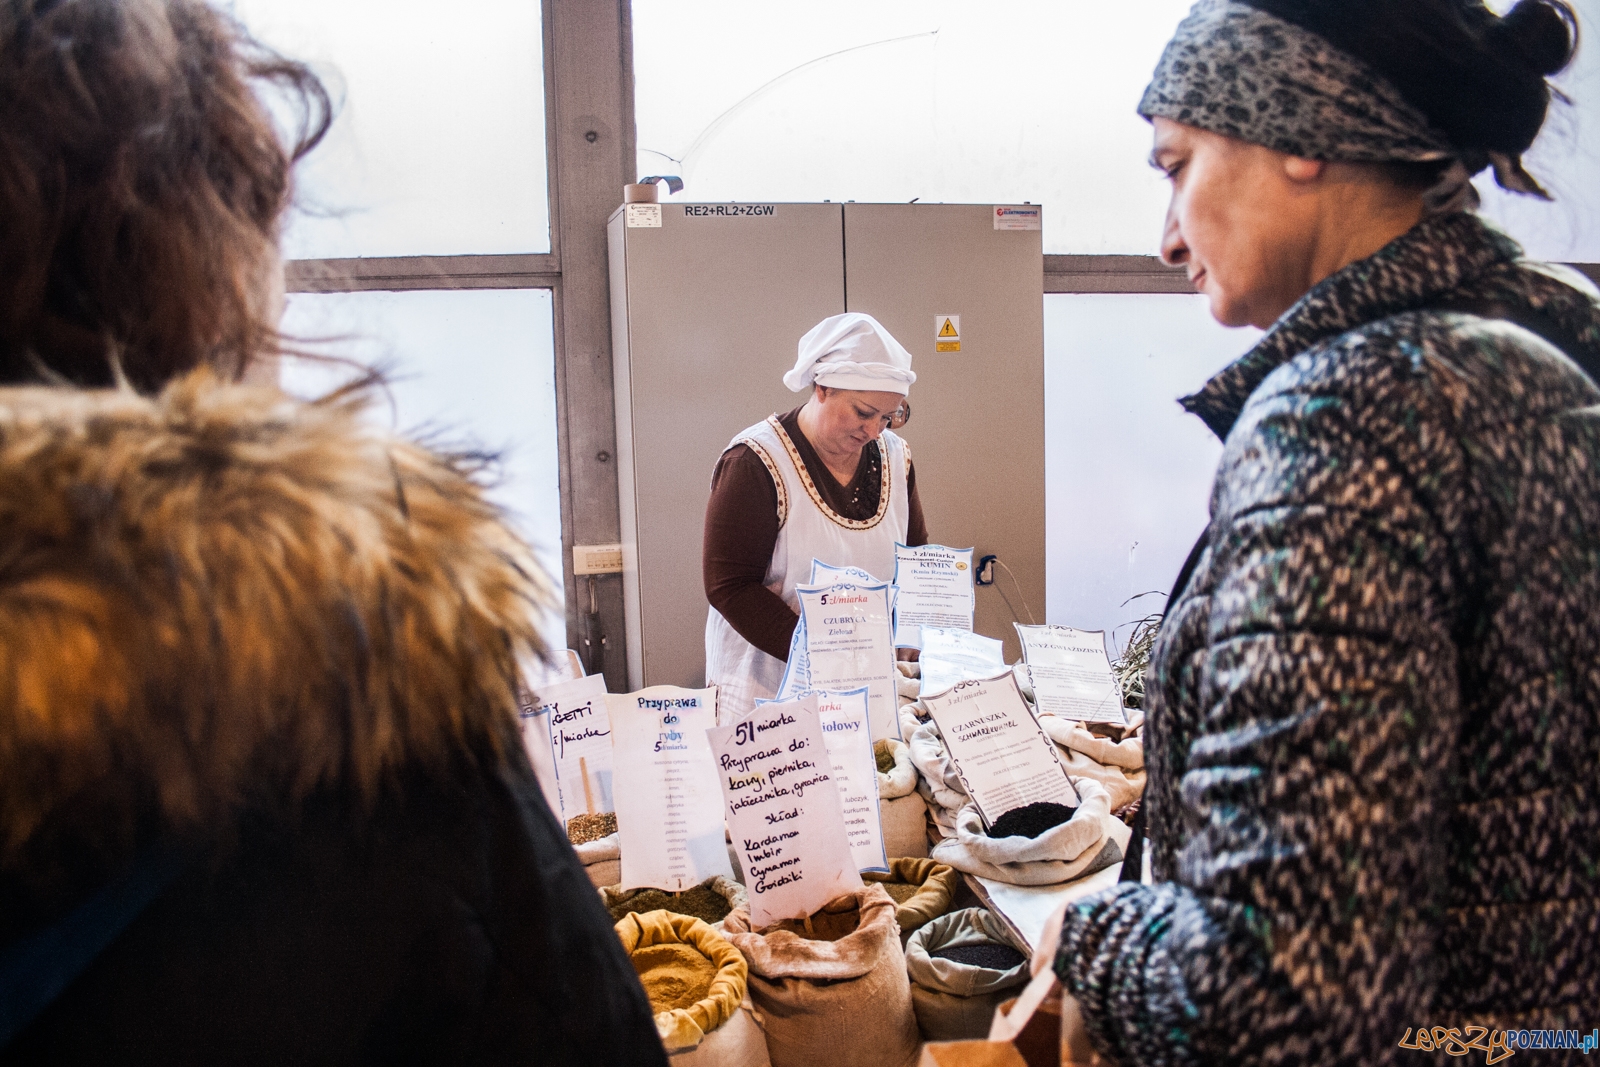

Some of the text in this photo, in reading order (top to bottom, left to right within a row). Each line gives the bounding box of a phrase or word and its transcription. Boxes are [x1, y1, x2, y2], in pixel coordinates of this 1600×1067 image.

[685, 205, 775, 216] RE2+RL2+ZGW
[820, 593, 829, 606] 5
[823, 616, 867, 625] CZUBRYCA
[828, 628, 853, 636] Zielona
[637, 697, 698, 711] Przyprawa
[552, 701, 592, 726] GETTI
[663, 712, 678, 724] do
[757, 713, 797, 733] miarka
[822, 720, 861, 733] iołowy
[951, 711, 1007, 733] CZARNUSZKA
[659, 729, 685, 744] ryby
[653, 741, 663, 752] 5
[720, 737, 810, 773] Przyprawa do:
[729, 759, 816, 793] kawy, piernika,
[845, 818, 867, 826] eradka,
[743, 830, 800, 851] Kardamon
[848, 829, 871, 838] operek,
[747, 847, 783, 863] Imbir
[750, 857, 801, 881] Cynamon
